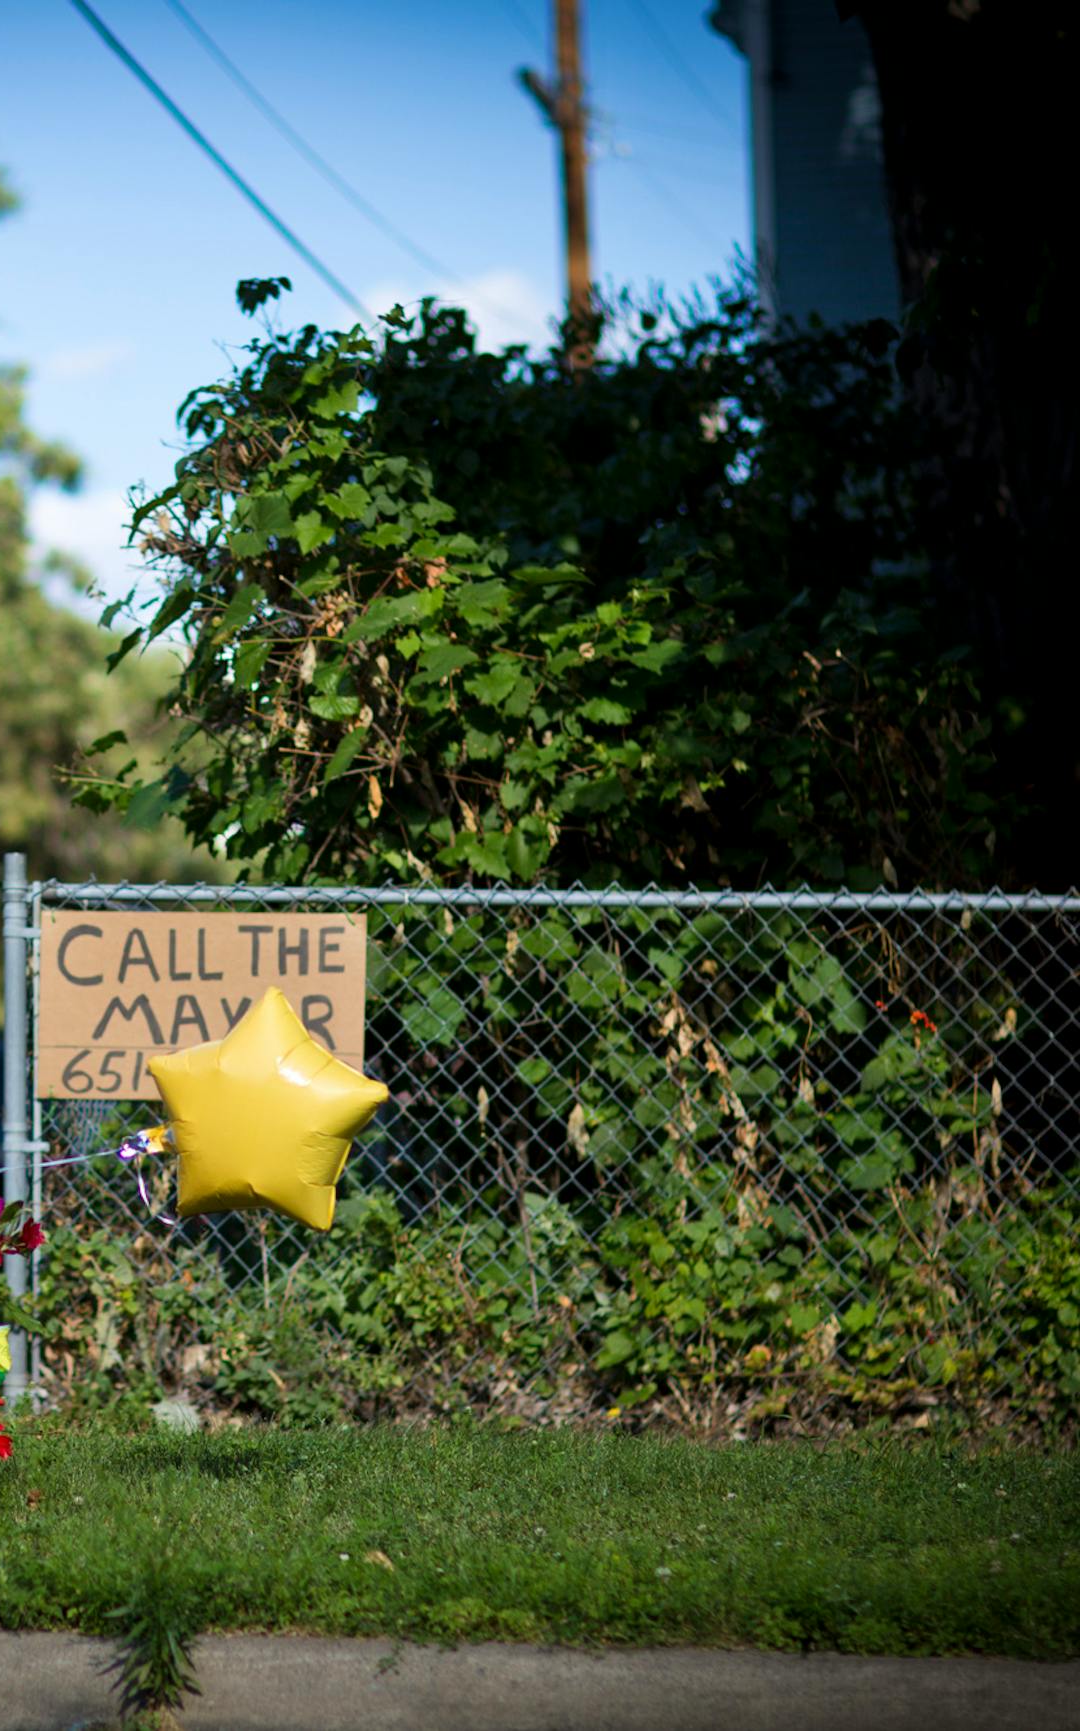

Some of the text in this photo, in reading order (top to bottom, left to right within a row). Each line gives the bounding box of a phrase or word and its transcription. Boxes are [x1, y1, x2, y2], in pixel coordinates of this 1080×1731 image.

[57, 924, 346, 986] CALL THE
[92, 994, 336, 1050] MAYR
